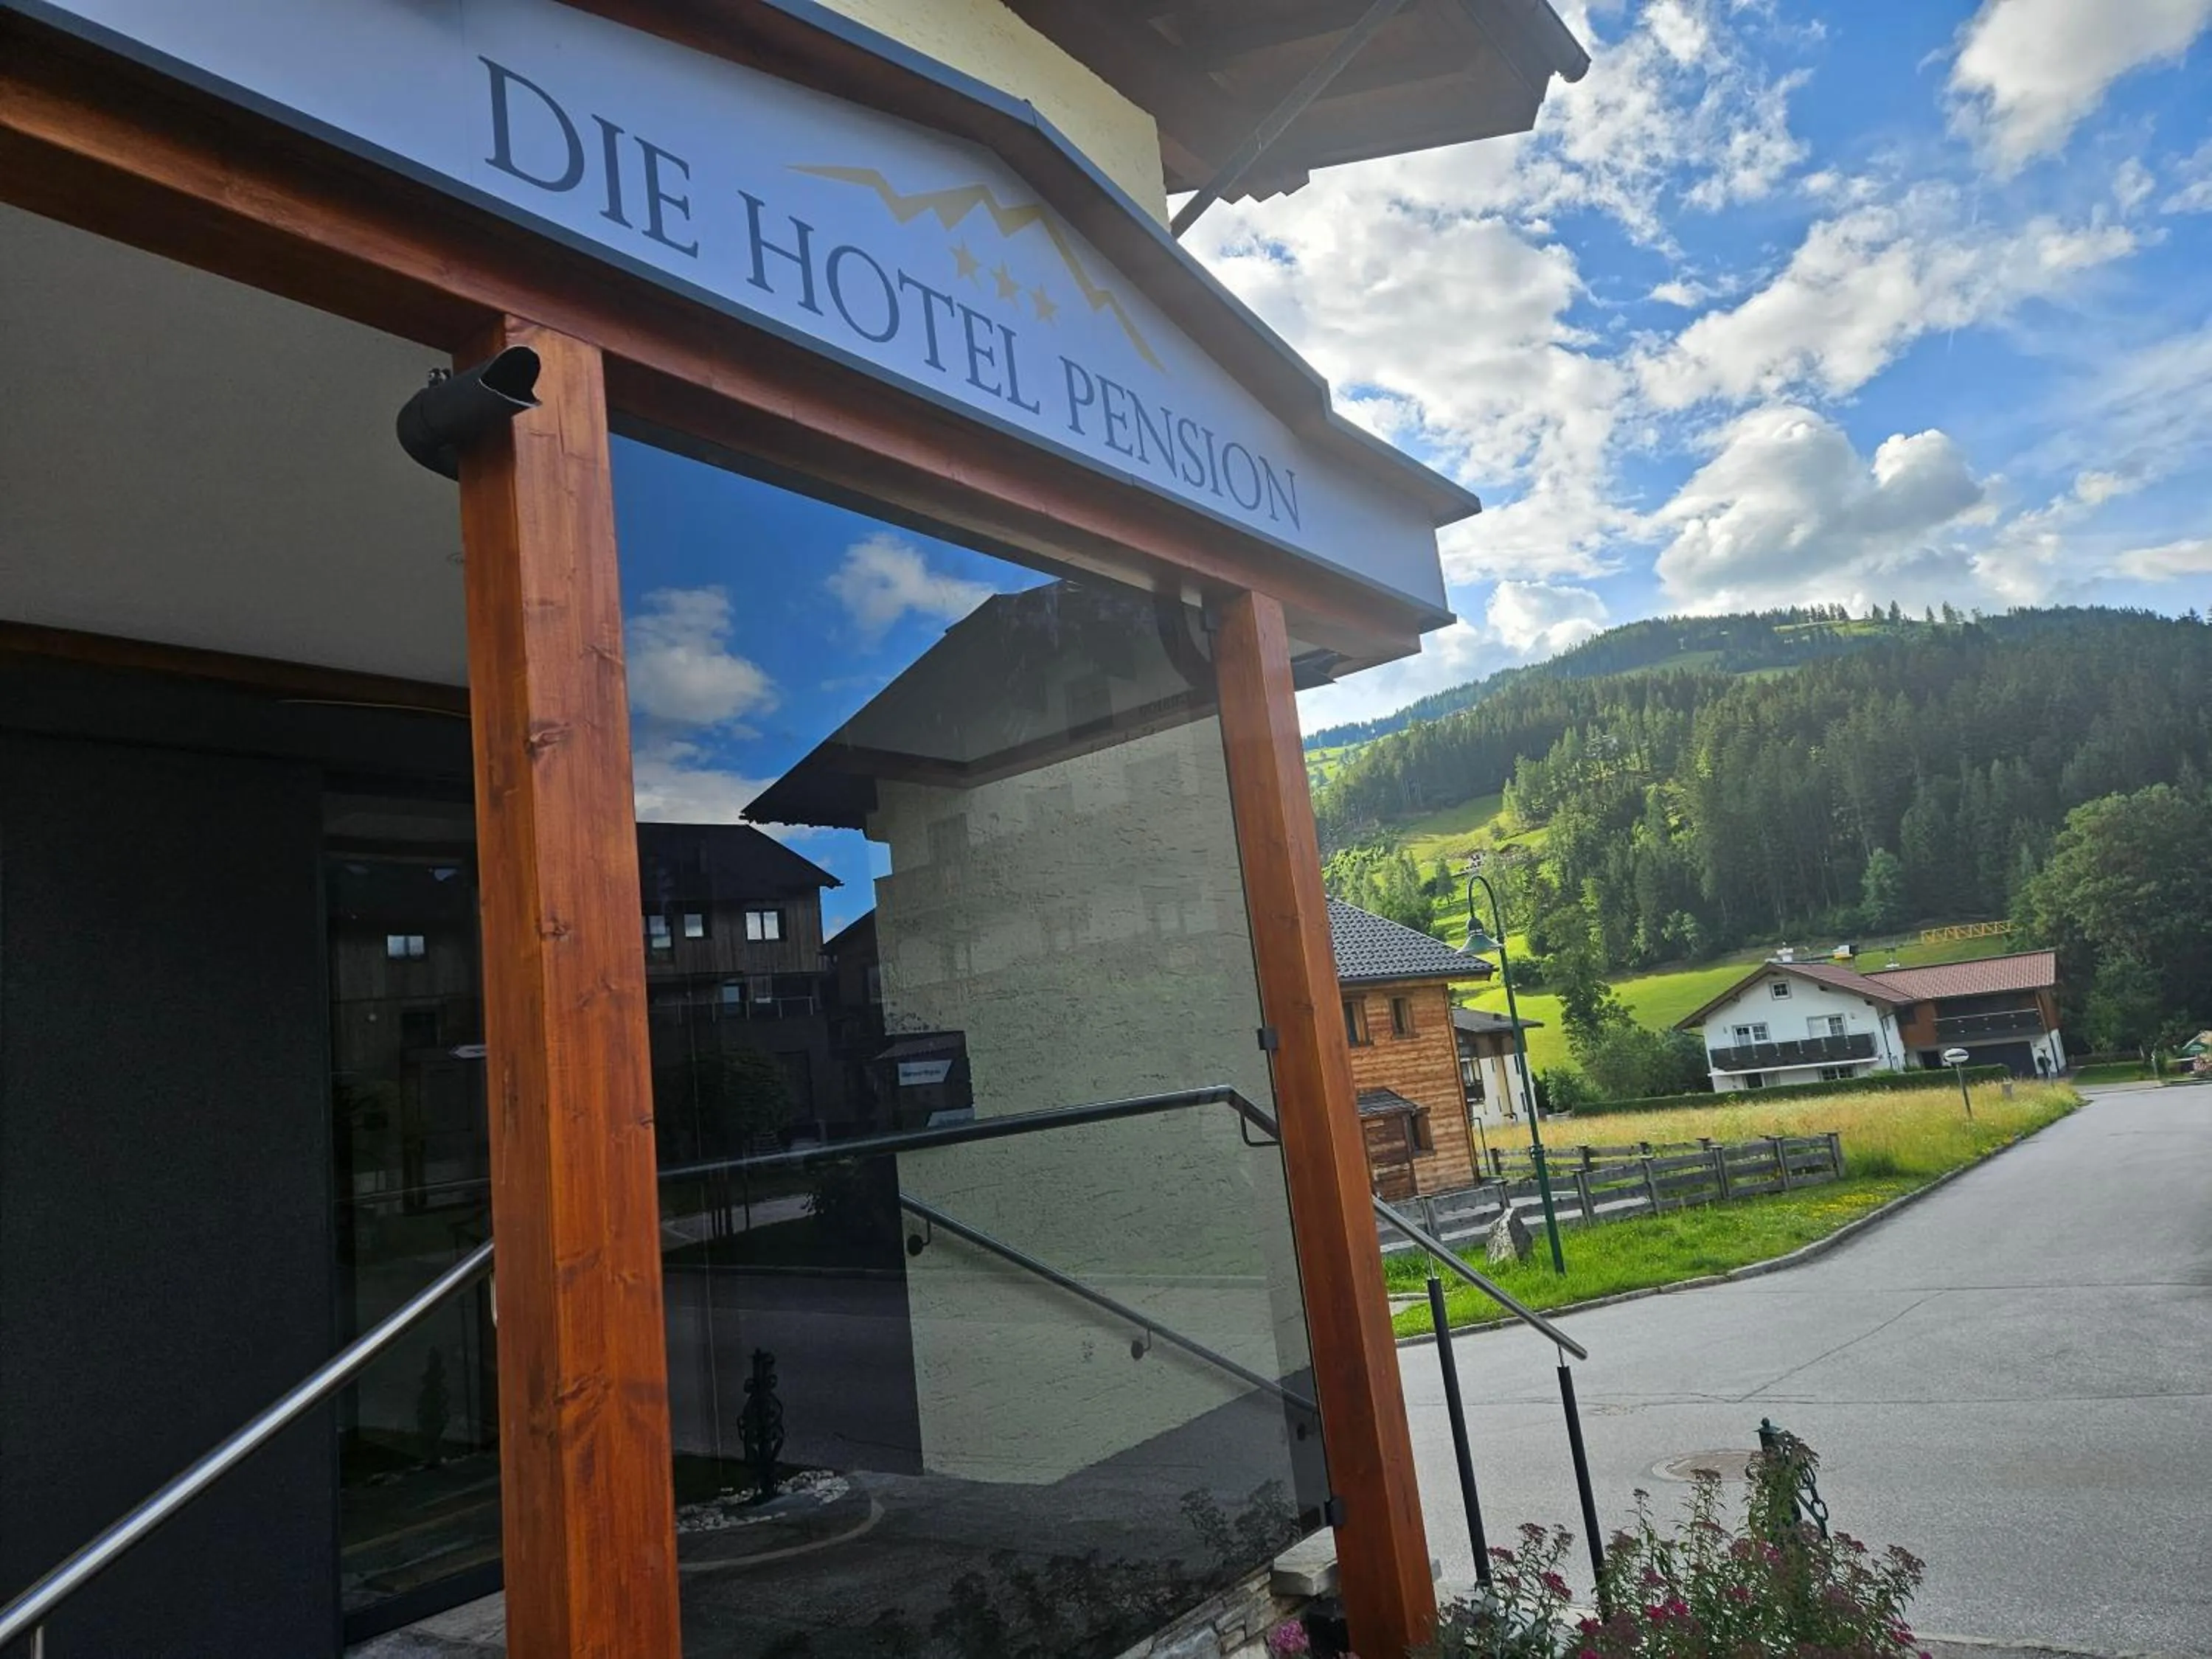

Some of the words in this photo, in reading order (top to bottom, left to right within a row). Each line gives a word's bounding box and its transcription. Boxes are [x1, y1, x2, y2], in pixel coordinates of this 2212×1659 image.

[478, 54, 698, 259] DIE
[737, 189, 1040, 415] HOTEL
[1058, 355, 1301, 532] PENSION
